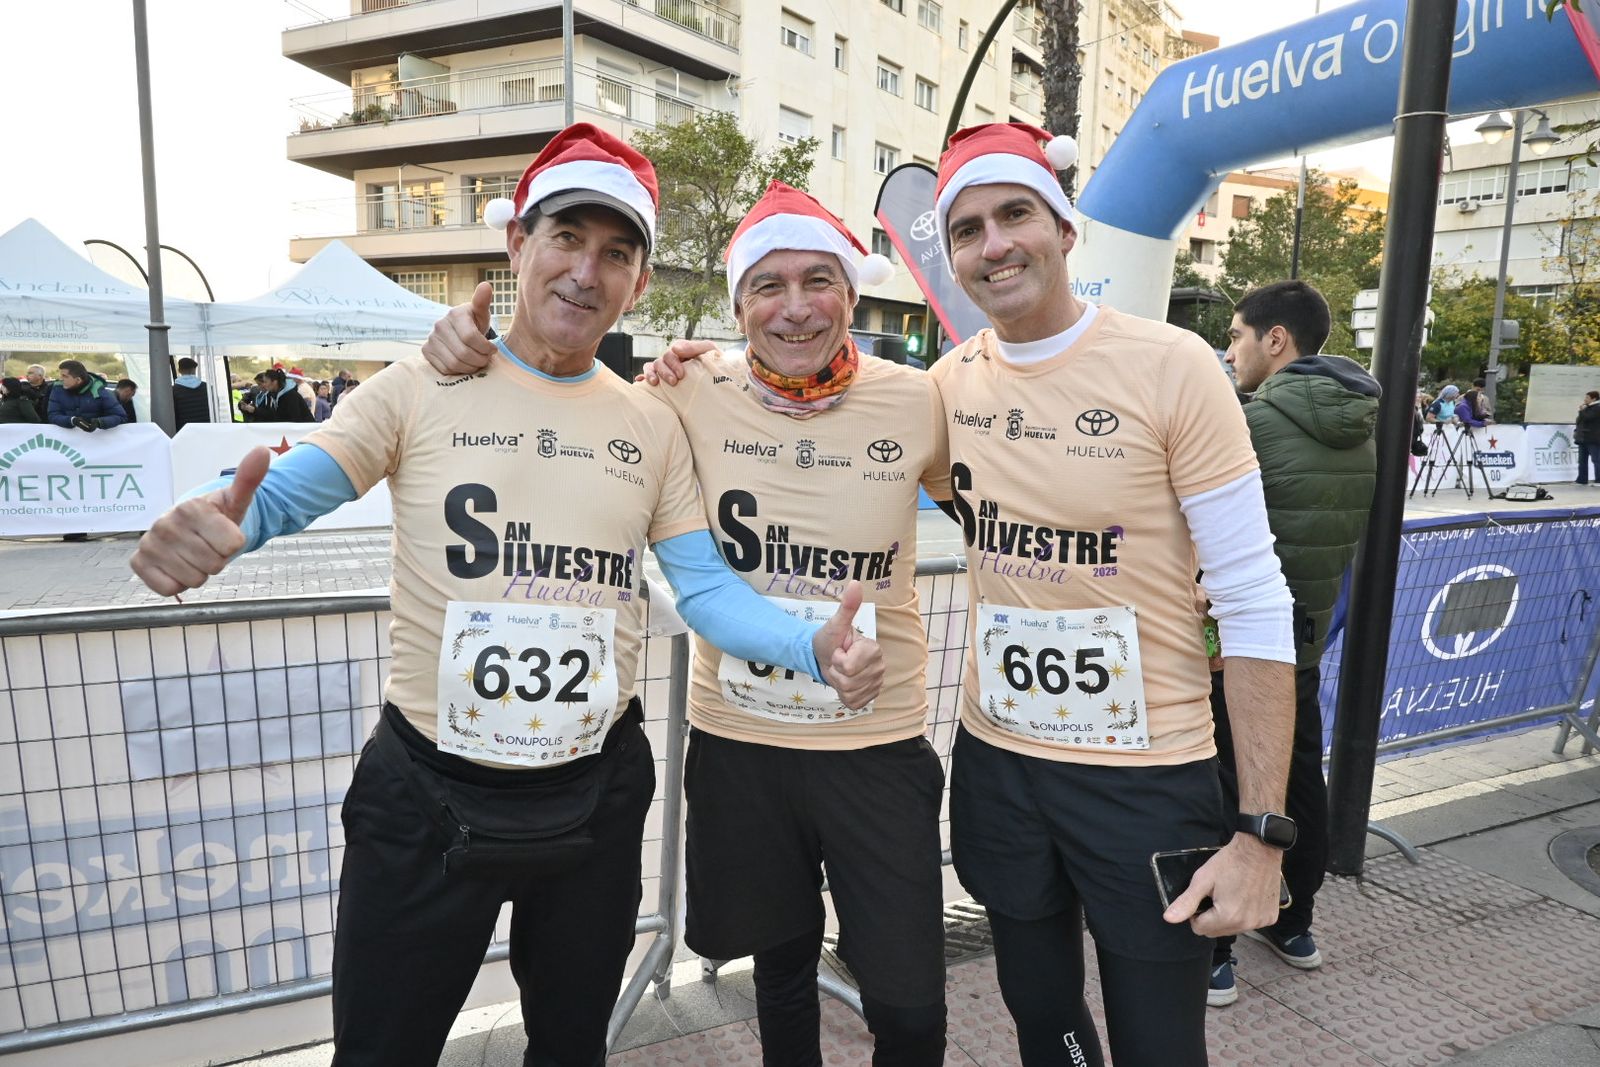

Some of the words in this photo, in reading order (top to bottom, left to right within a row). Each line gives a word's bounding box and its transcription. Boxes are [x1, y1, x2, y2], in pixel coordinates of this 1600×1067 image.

[1182, 33, 1344, 119] Huelva
[953, 409, 992, 428] Huelva
[452, 432, 518, 447] Huelva
[1024, 431, 1056, 440] HUELVA
[560, 450, 595, 460] HUELVA
[723, 439, 777, 457] Huelva
[1066, 445, 1126, 459] HUELVA
[818, 459, 852, 468] HUELVA
[605, 466, 645, 488] HUELVA
[863, 471, 906, 482] HUELVA
[57, 505, 80, 516] que
[83, 503, 146, 514] transforma
[980, 543, 1073, 585] Huelva
[1093, 566, 1118, 578] 2025
[766, 564, 844, 597] Huelv
[876, 579, 892, 591] 2025
[617, 590, 632, 602] 2025
[472, 645, 590, 702] 632
[1003, 644, 1110, 695] 665
[1040, 722, 1094, 732] ONUPOLIS
